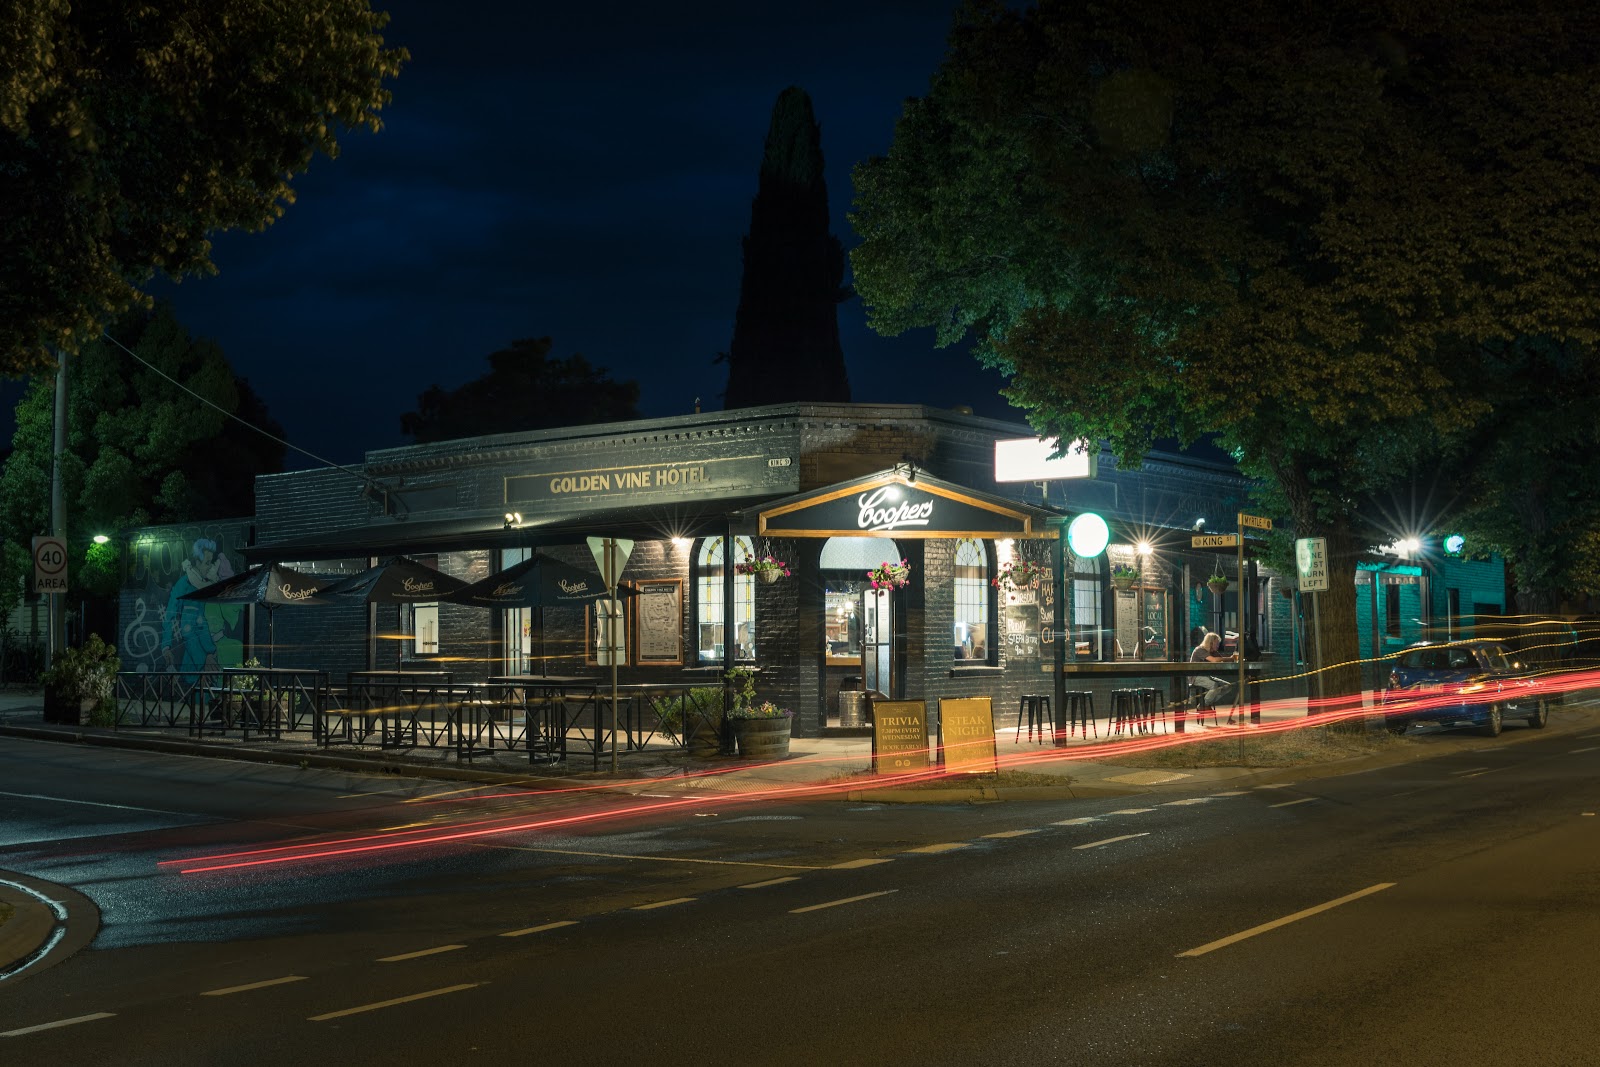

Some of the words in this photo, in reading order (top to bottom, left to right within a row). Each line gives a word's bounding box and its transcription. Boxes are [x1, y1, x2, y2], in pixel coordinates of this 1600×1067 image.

[549, 474, 611, 494] GOLDEN
[614, 470, 651, 489] VINE
[656, 466, 711, 486] HOTEL
[858, 486, 934, 531] Coopers
[1244, 516, 1262, 528] MYRTLE
[1202, 536, 1223, 546] KING
[41, 550, 62, 566] 40
[1302, 570, 1324, 579] TURN
[37, 578, 67, 589] AREA
[402, 577, 434, 593] Coopers
[558, 579, 588, 595] Coopers
[1303, 580, 1323, 588] LEFT
[278, 583, 318, 601] Coopers
[1147, 611, 1163, 621] LOCAL
[1008, 633, 1025, 645] STEPH
[880, 716, 920, 726] TRIVIA
[948, 715, 986, 726] STEAK
[949, 726, 987, 736] NIGHT
